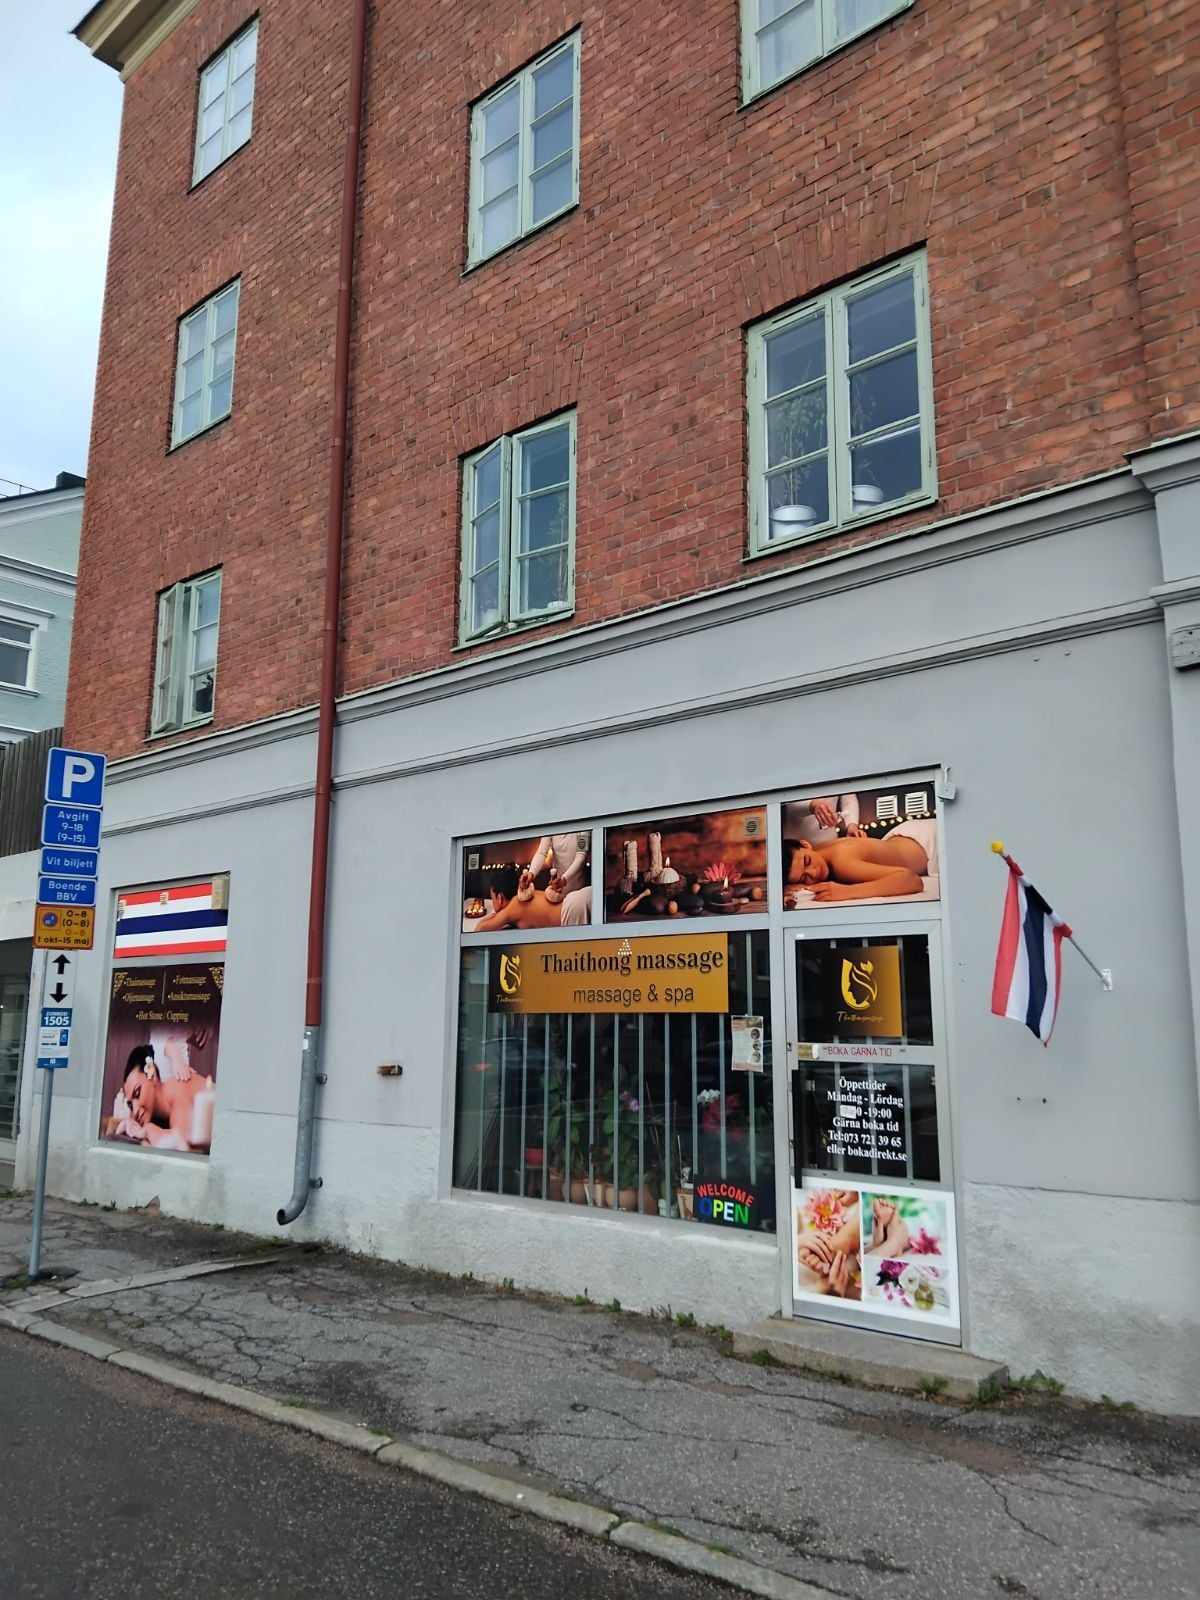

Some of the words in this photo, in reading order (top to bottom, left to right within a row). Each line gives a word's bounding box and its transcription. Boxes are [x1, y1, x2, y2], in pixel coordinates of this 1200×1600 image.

[62, 755, 96, 798] P
[57, 810, 89, 821] Avgift
[46, 857, 61, 866] Vit
[63, 858, 93, 868] biljett
[48, 881, 87, 891] Boende
[540, 952, 632, 976] Thaithong
[637, 950, 724, 974] massage
[573, 986, 642, 1007] massage
[647, 983, 659, 1001] &
[664, 986, 694, 1006] spa
[44, 1016, 69, 1025] 1505
[839, 1076, 887, 1091] Öppettider
[870, 1093, 904, 1109] Lördag
[862, 1118, 884, 1131] boka
[886, 1121, 899, 1132] tid
[861, 1133, 876, 1146] 721
[878, 1135, 889, 1146] 39
[891, 1136, 902, 1148] 65
[826, 1143, 847, 1155] eller
[847, 1145, 908, 1161] bokadirekt.se
[697, 1184, 754, 1207] WELCOME
[698, 1198, 749, 1224] OPEN
